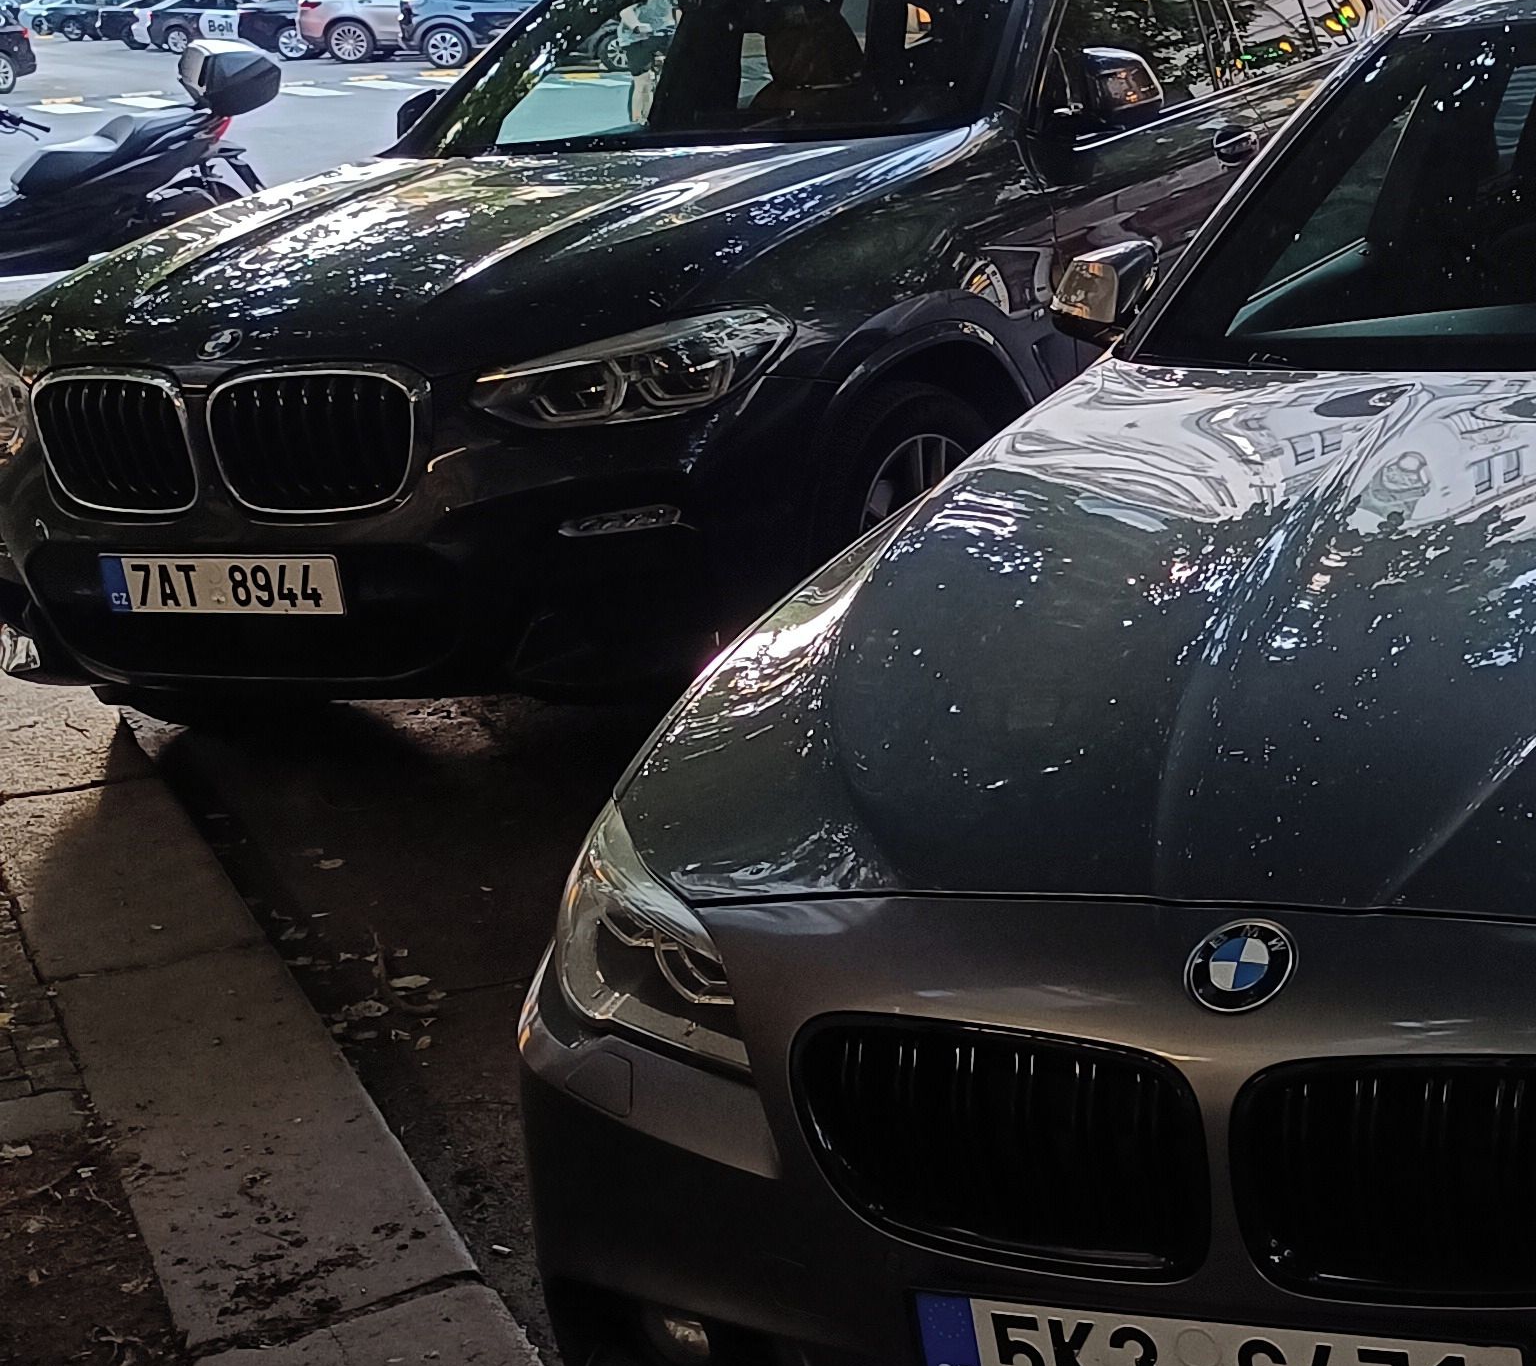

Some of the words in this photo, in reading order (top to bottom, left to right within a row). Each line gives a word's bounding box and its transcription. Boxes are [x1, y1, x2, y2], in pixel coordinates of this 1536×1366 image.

[207, 19, 234, 36] Bolt
[131, 564, 198, 607] 7AT
[228, 564, 322, 607] 8944
[111, 592, 129, 605] CZ
[1209, 925, 1287, 952] BMW
